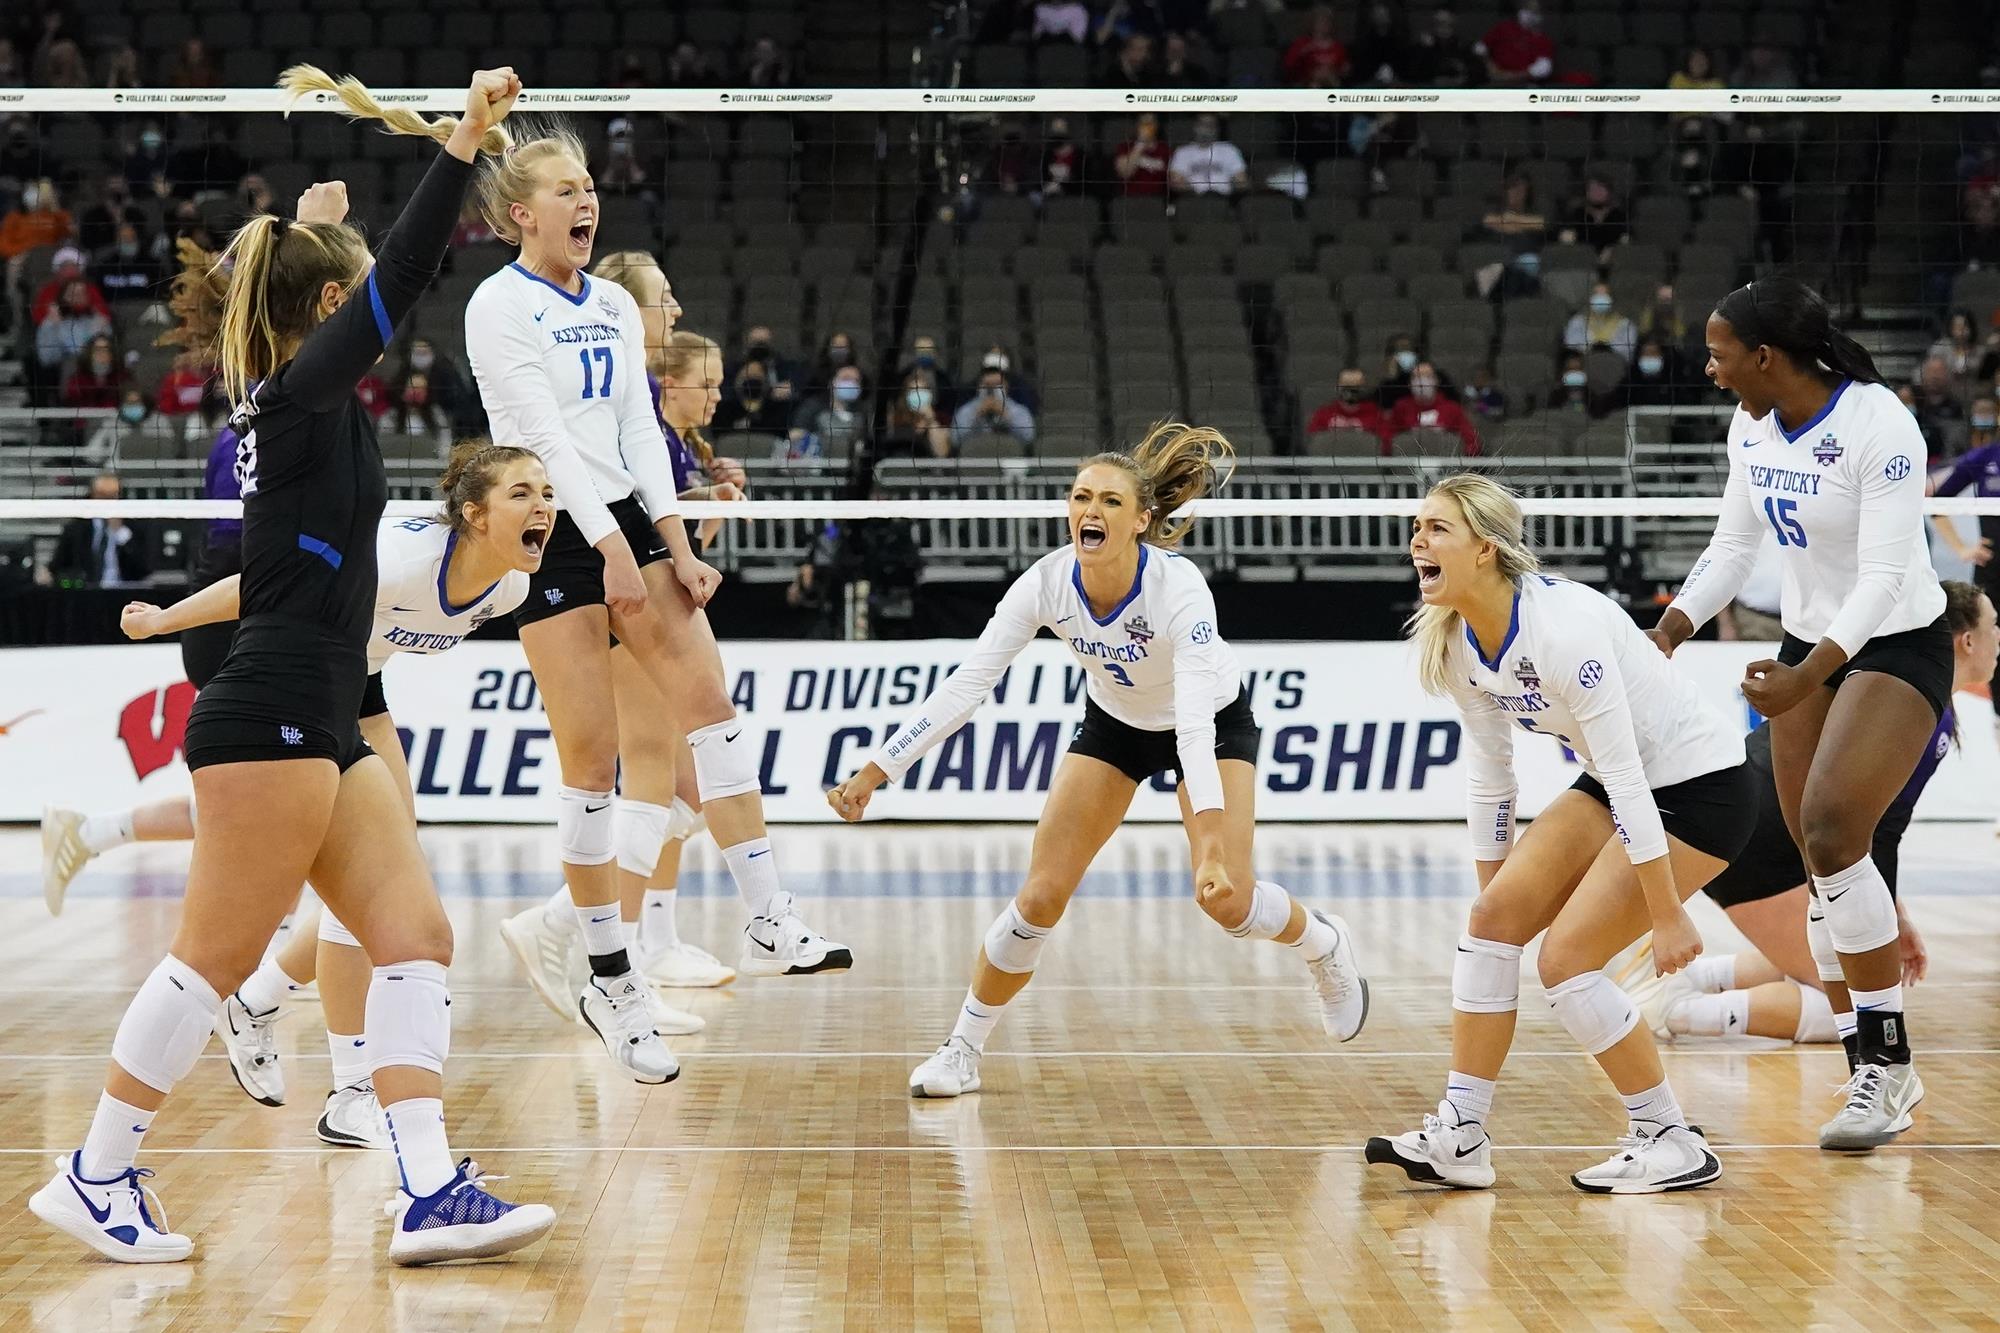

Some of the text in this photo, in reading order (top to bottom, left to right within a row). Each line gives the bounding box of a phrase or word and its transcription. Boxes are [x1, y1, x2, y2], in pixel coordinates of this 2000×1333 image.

[126, 94, 226, 103] VOLLEYBALL CHAMPIONSHIP
[529, 94, 631, 103] VOLLEYBALL CHAMPIONSHIP
[731, 94, 833, 103] VOLLEYBALL CHAMPIONSHIP
[934, 94, 1036, 103] VOLLEYBALL CHAMPIONSHIP
[1136, 94, 1238, 103] VOLLEYBALL CHAMPIONSHIP
[1338, 94, 1440, 103] VOLLEYBALL CHAMPIONSHIP
[1539, 94, 1641, 103] VOLLEYBALL CHAMPIONSHIP
[1741, 94, 1842, 103] VOLLEYBALL CHAMPIONSHIP
[1942, 95, 1985, 103] VOLLEYBALL
[579, 346, 614, 399] 17
[1750, 465, 1821, 495] KENTUCKY
[1764, 496, 1808, 549] 15
[1103, 663, 1135, 687] 3
[888, 717, 932, 757] GO BIG BLUE
[1496, 812, 1509, 828] BIG
[1495, 830, 1508, 842] GO
